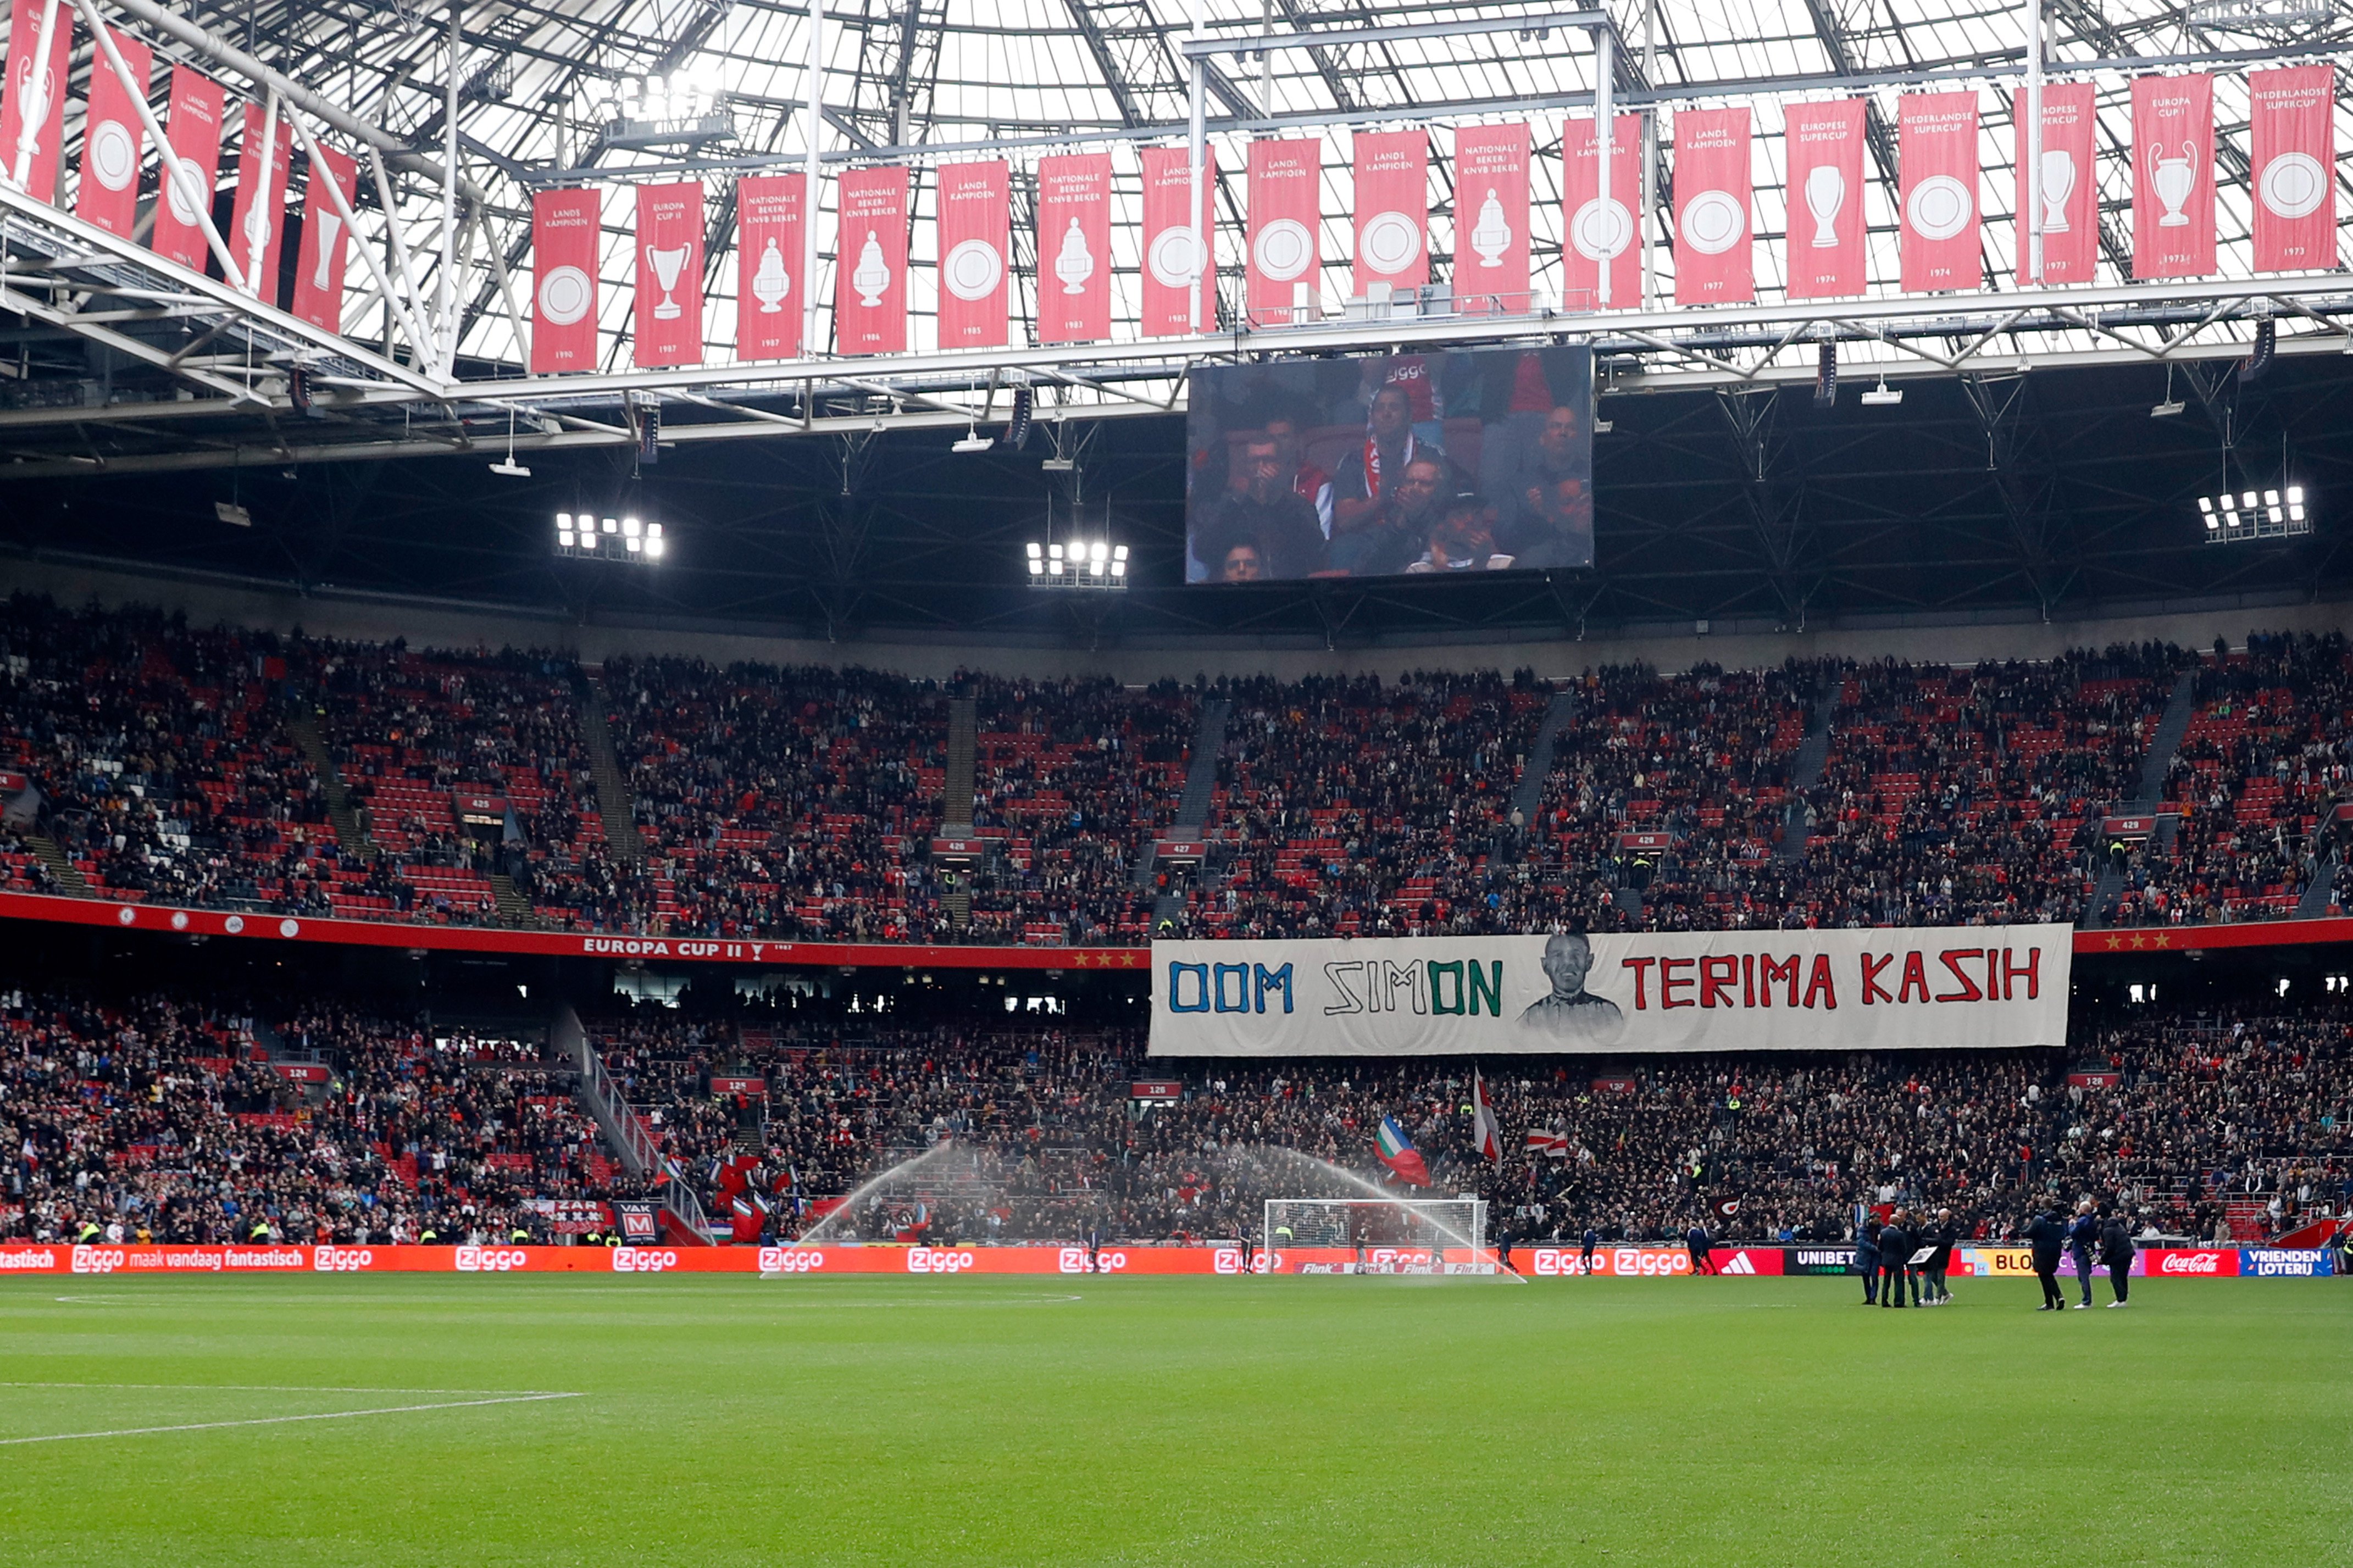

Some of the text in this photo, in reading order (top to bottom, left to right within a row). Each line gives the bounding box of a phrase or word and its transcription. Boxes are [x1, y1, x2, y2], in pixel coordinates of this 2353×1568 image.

[2255, 87, 2326, 99] NEDERLANDSE
[2153, 97, 2190, 107] EUROPA
[2266, 99, 2316, 109] SUPERCUP
[2043, 105, 2077, 114] ROPESE
[2158, 109, 2178, 117] CUP
[1904, 112, 1972, 124] NEDERLANDSE
[2041, 116, 2078, 125] PERCUP
[1801, 121, 1846, 132] EUROPESE
[1914, 124, 1962, 134] SUPERCUP
[1696, 129, 1727, 138] LANDS
[1800, 132, 1847, 142] SUPERCUP
[1688, 139, 1735, 149] KAMPIOEN
[1466, 144, 1517, 154] NATIONALE
[1375, 152, 1404, 161] LANDS
[1477, 155, 1506, 164] BEKER/
[1269, 160, 1297, 169] LANDS
[1366, 162, 1412, 171] KAMPIOEN
[1464, 164, 1518, 174] KNVB BEKER
[1259, 169, 1306, 178] KAMPIOEN
[1050, 174, 1099, 183] NATIONALE
[959, 181, 987, 190] LANDS
[1060, 185, 1089, 193] BEKER/
[848, 188, 895, 198] NATIONALE
[951, 191, 994, 200] KAMPIOEN
[1074, 193, 1100, 202] BEKER
[749, 195, 796, 204] NATIONALE
[858, 198, 885, 207] BEKER/
[653, 203, 685, 212] EUROPA
[872, 207, 897, 215] BEKER
[553, 209, 580, 218] LANDS
[546, 219, 587, 227] KAMPIOEN
[772, 214, 796, 223] BEKER
[2285, 247, 2304, 255] 1973
[1704, 282, 1723, 290] 1977
[473, 800, 490, 808] 425
[583, 938, 669, 955] EUROPA
[678, 943, 719, 957] CUP
[728, 945, 741, 958] II
[1169, 947, 2040, 1017] OOM SIMON TERIMA KASIH
[290, 1069, 307, 1078] 124
[729, 1082, 746, 1090] 125
[559, 1201, 597, 1210] ZAR
[620, 1204, 651, 1213] VAK
[628, 1216, 651, 1232] M
[0, 1249, 54, 1268] tastisch
[130, 1250, 164, 1267] maak
[166, 1249, 221, 1270] vandaag
[225, 1249, 302, 1266] fantastisch
[1797, 1251, 1856, 1264] UNIBET
[2249, 1250, 2321, 1263] VRIENDEN
[1996, 1255, 2032, 1269] BLO
[2162, 1253, 2220, 1272] Coca-Cola
[1302, 1264, 1332, 1274] Flink
[2258, 1263, 2312, 1276] LOTERIJ
